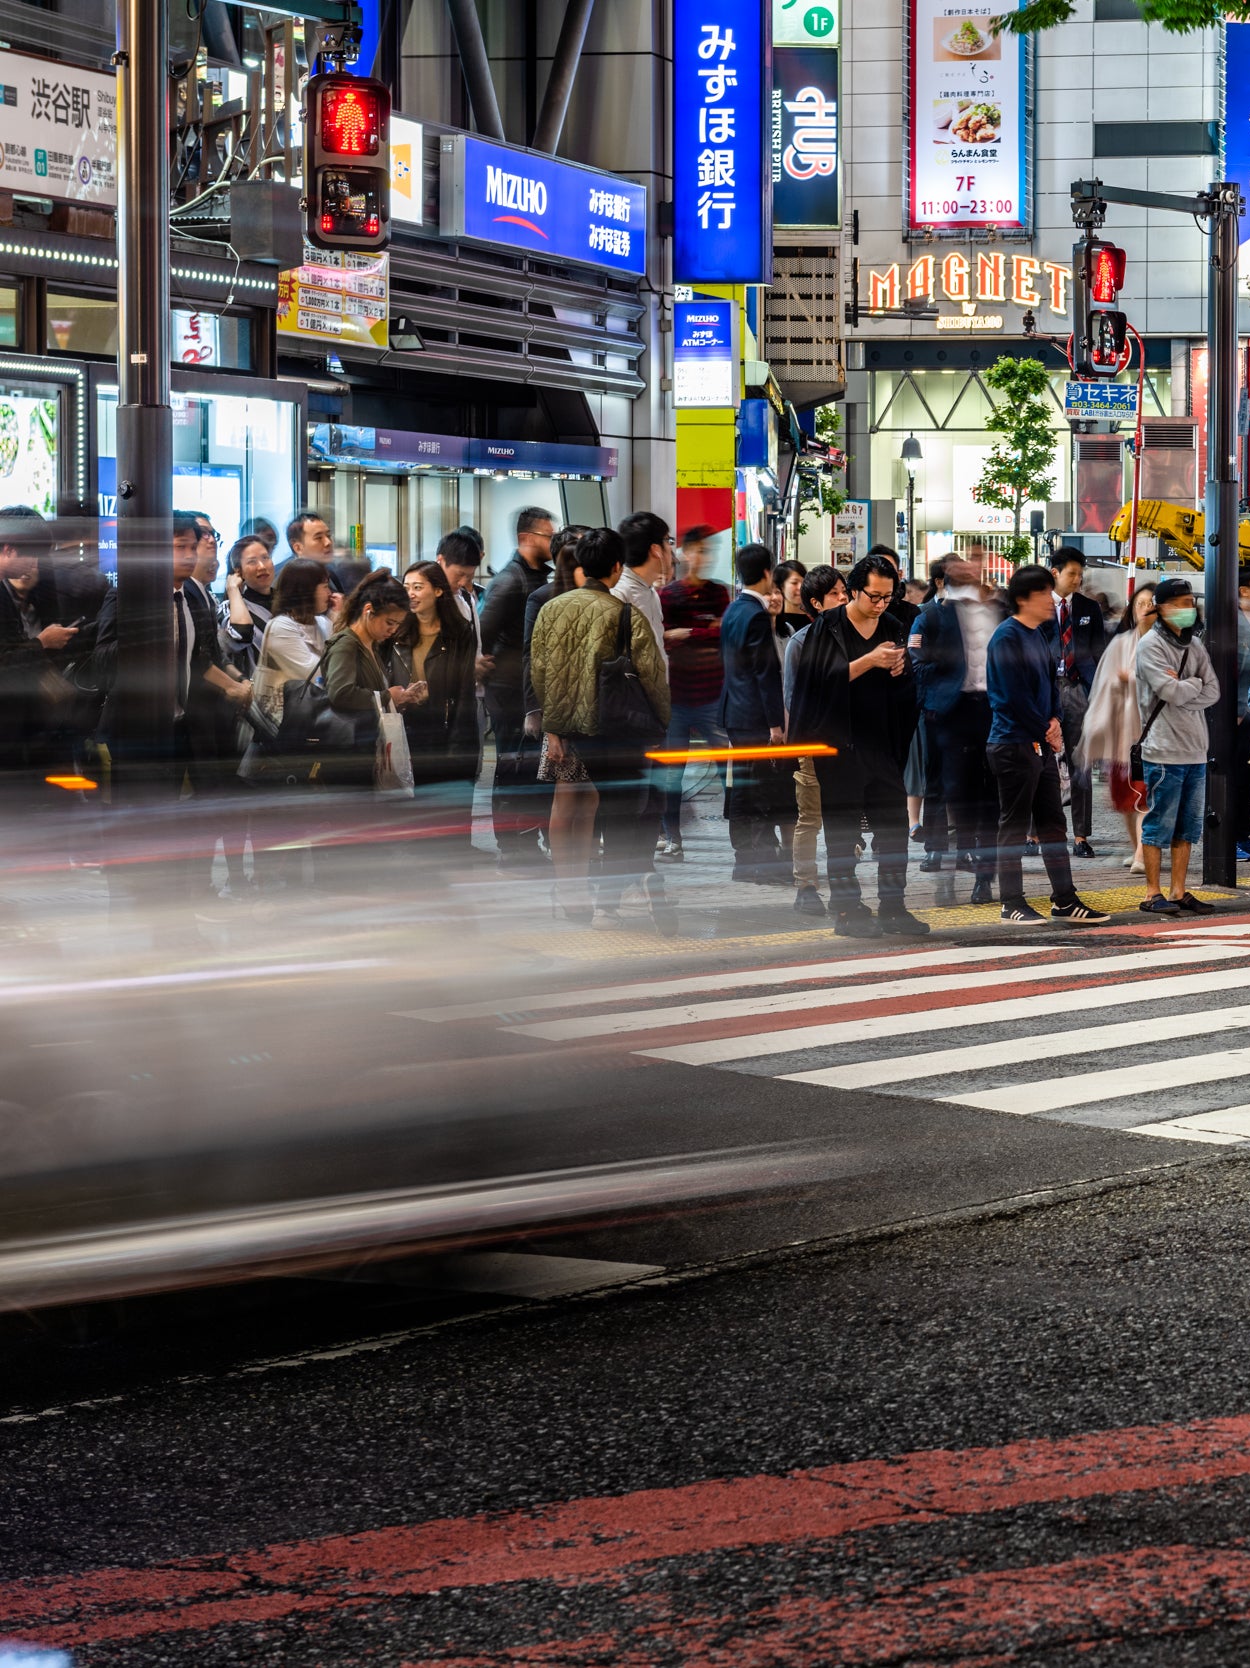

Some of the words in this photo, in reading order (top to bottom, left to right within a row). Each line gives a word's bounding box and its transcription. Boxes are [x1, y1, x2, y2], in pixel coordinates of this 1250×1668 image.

[811, 13, 829, 31] 1F
[31, 77, 91, 129] 渋谷駅
[97, 90, 117, 108] Shibuy
[697, 25, 738, 229] みずほ銀行
[783, 87, 837, 180] HUB
[951, 149, 998, 158] らんまん食堂
[486, 165, 547, 215] MIZUHO
[956, 176, 976, 192] 7F
[589, 188, 631, 223] みずほ銀行
[589, 224, 631, 258] みずほ証券
[868, 251, 1073, 315] MAGNET
[686, 315, 719, 323] MIZUHO
[681, 339, 724, 347] ATMコーナー
[1084, 384, 1137, 402] セキネ
[487, 446, 515, 456] MIZUHO
